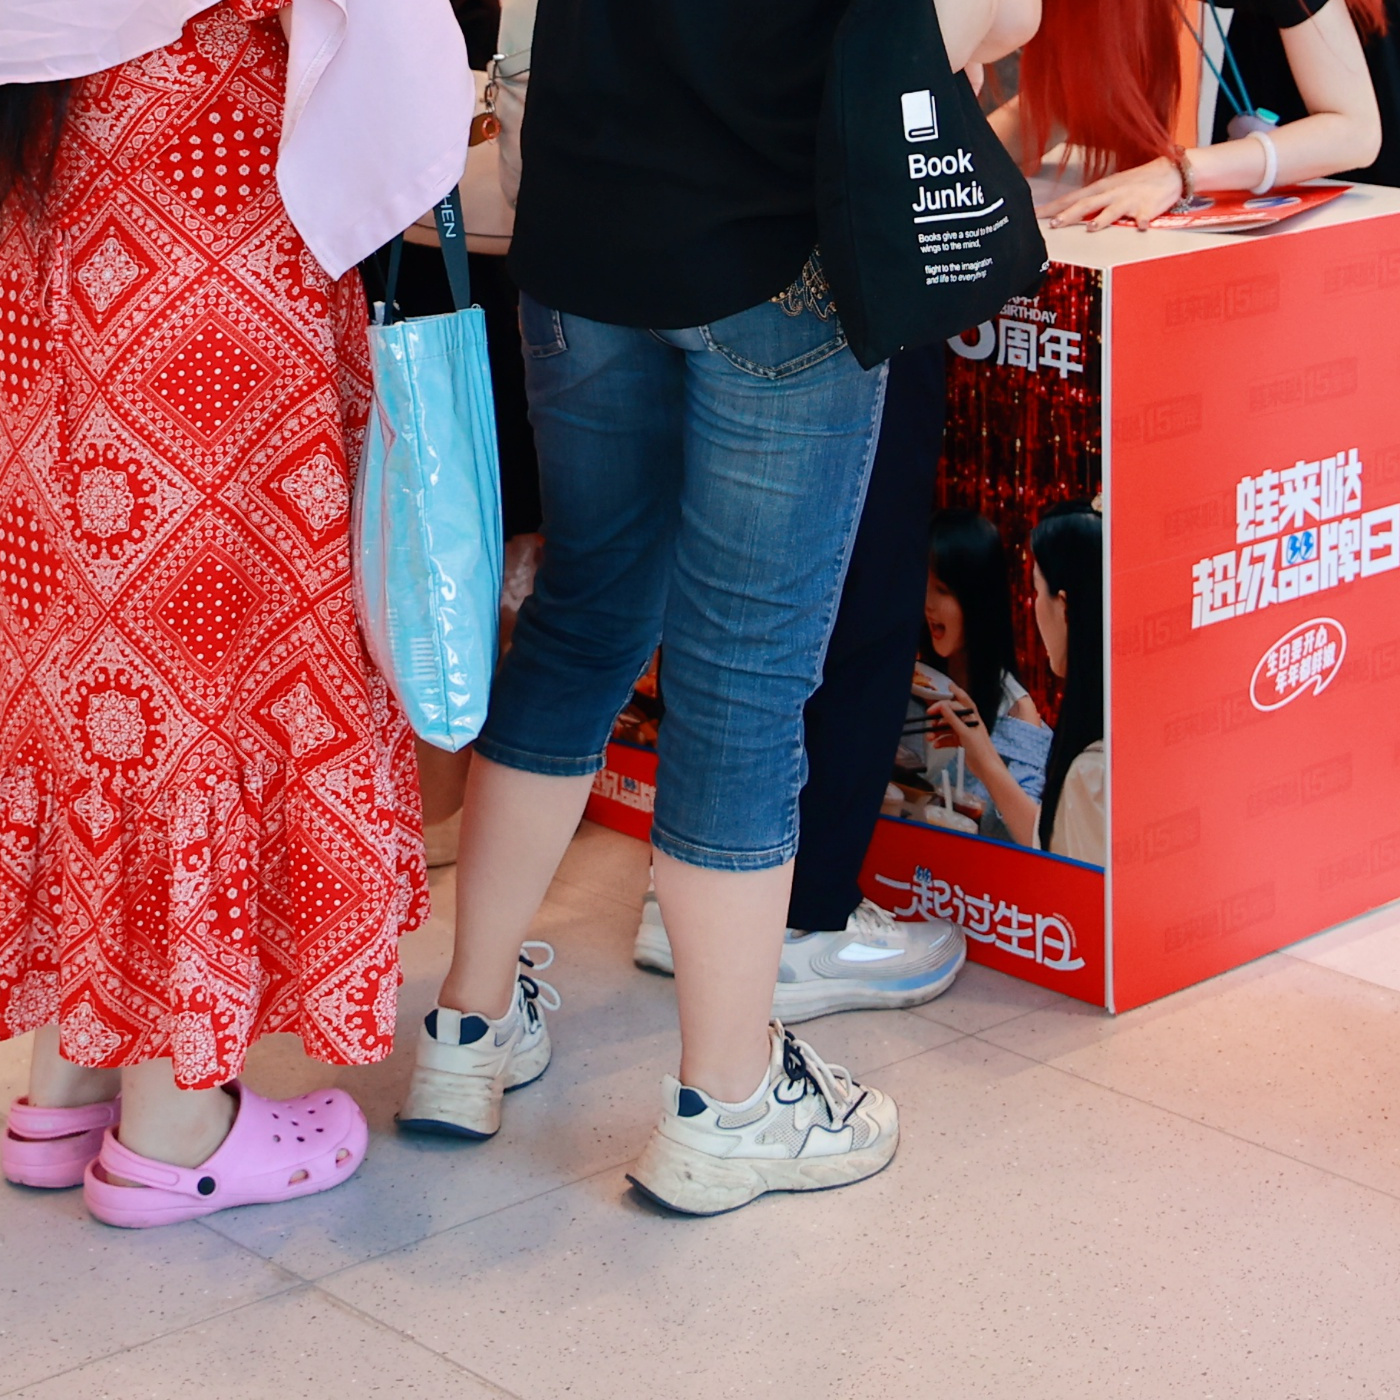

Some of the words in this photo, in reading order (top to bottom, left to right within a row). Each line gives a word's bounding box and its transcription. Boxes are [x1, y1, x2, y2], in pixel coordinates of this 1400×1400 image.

[908, 148, 974, 179] Book
[918, 232, 941, 243] Books
[942, 231, 958, 242] give
[958, 231, 964, 239] a
[965, 228, 979, 238] soul
[920, 244, 941, 254] wings
[942, 243, 949, 251] to
[950, 242, 961, 250] the
[942, 264, 949, 272] to
[949, 263, 960, 272] the
[926, 276, 939, 285] and
[939, 274, 949, 282] life
[950, 274, 957, 282] to
[999, 304, 1058, 324] BIRTHDAY
[1236, 448, 1362, 544] 蛙来哒
[874, 870, 1086, 971] 一起过生日
